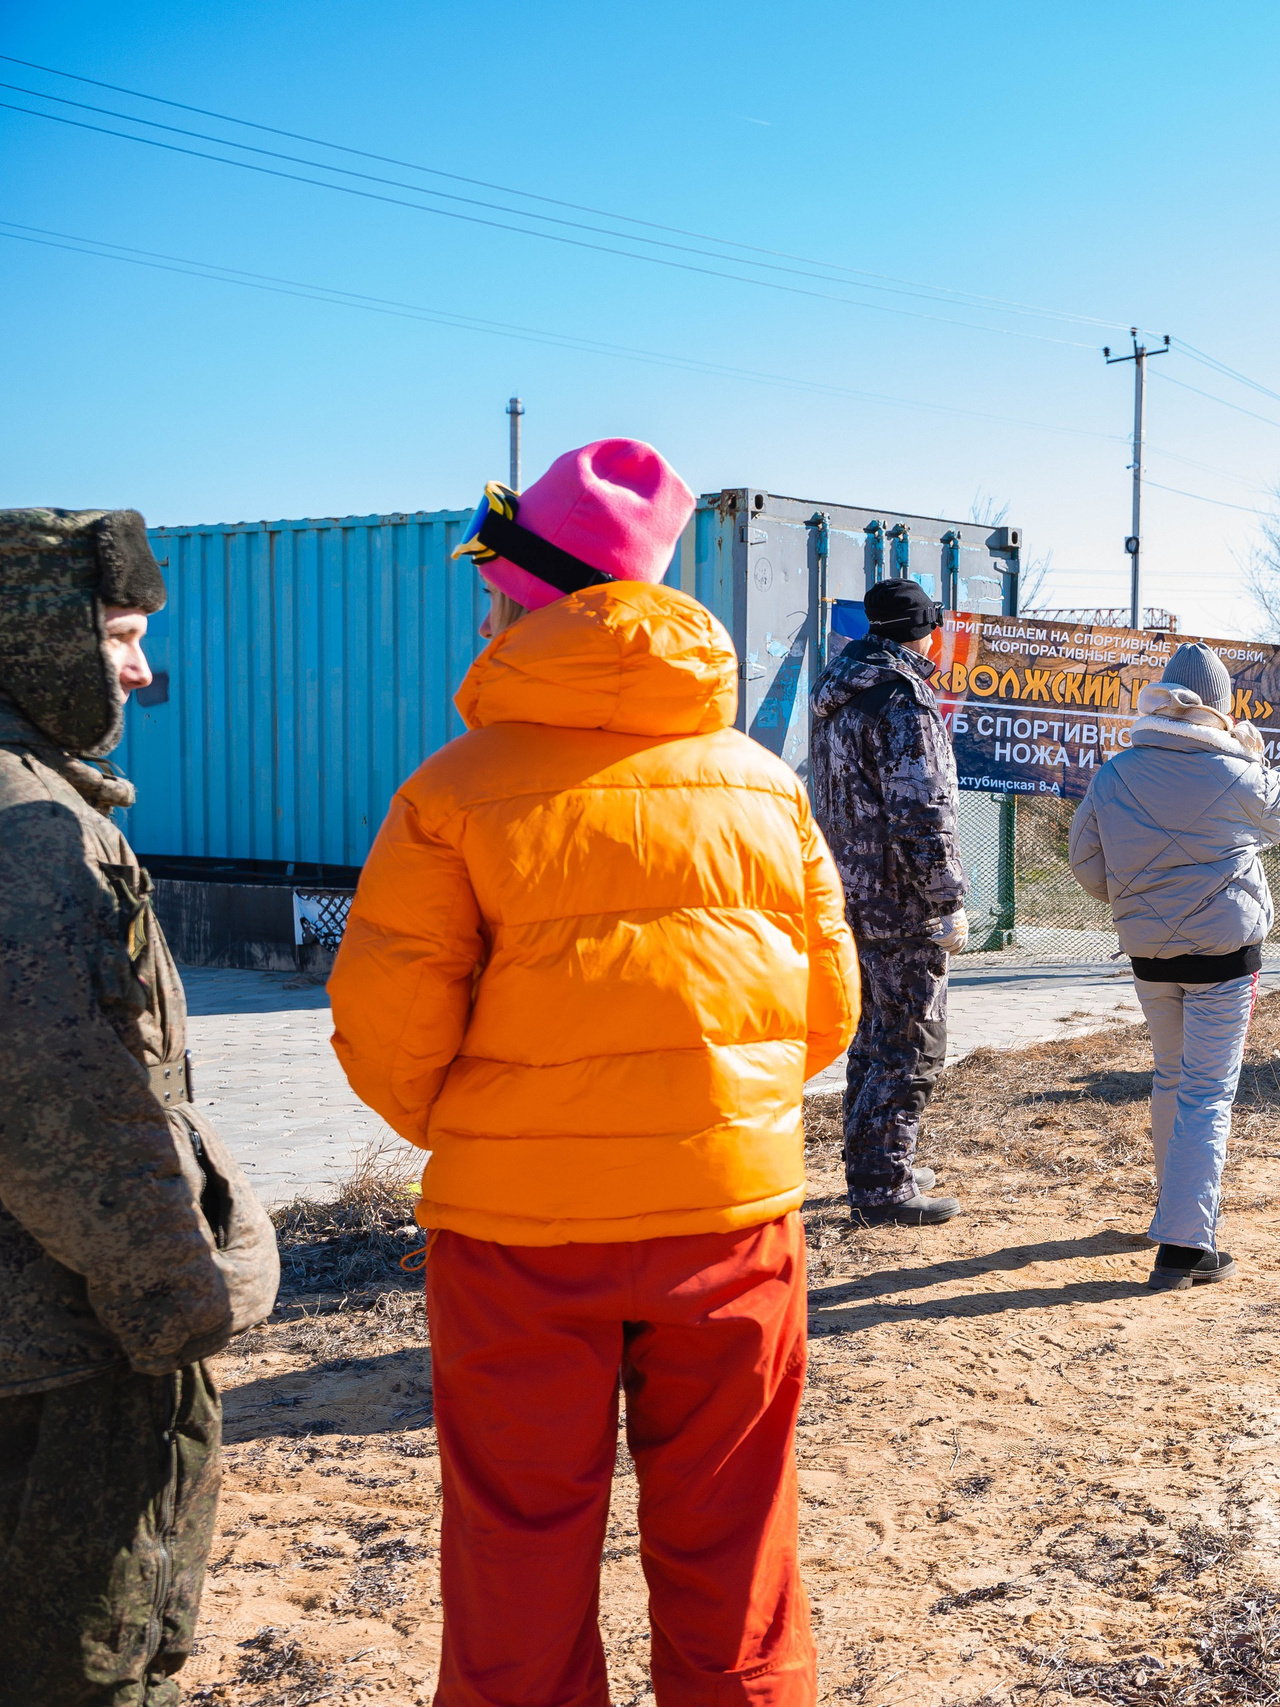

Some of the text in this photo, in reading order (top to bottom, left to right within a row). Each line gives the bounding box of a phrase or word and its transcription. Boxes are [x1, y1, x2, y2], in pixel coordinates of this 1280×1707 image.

[945, 620, 1047, 641] ПРИГЛАШАЕМ
[1050, 630, 1070, 643] НА
[1074, 632, 1171, 653] СПОРТИВНЫЕ
[991, 640, 1171, 668] КОРПОРАТИВНЫЕ МЕРОП
[929, 662, 1121, 708] «ВОЛЖСКИЙ
[977, 714, 1133, 748] СПОРТИВНО
[994, 741, 1071, 767] НОЖА
[1078, 748, 1095, 769] И
[957, 775, 1060, 793] хтубинская 8-А
